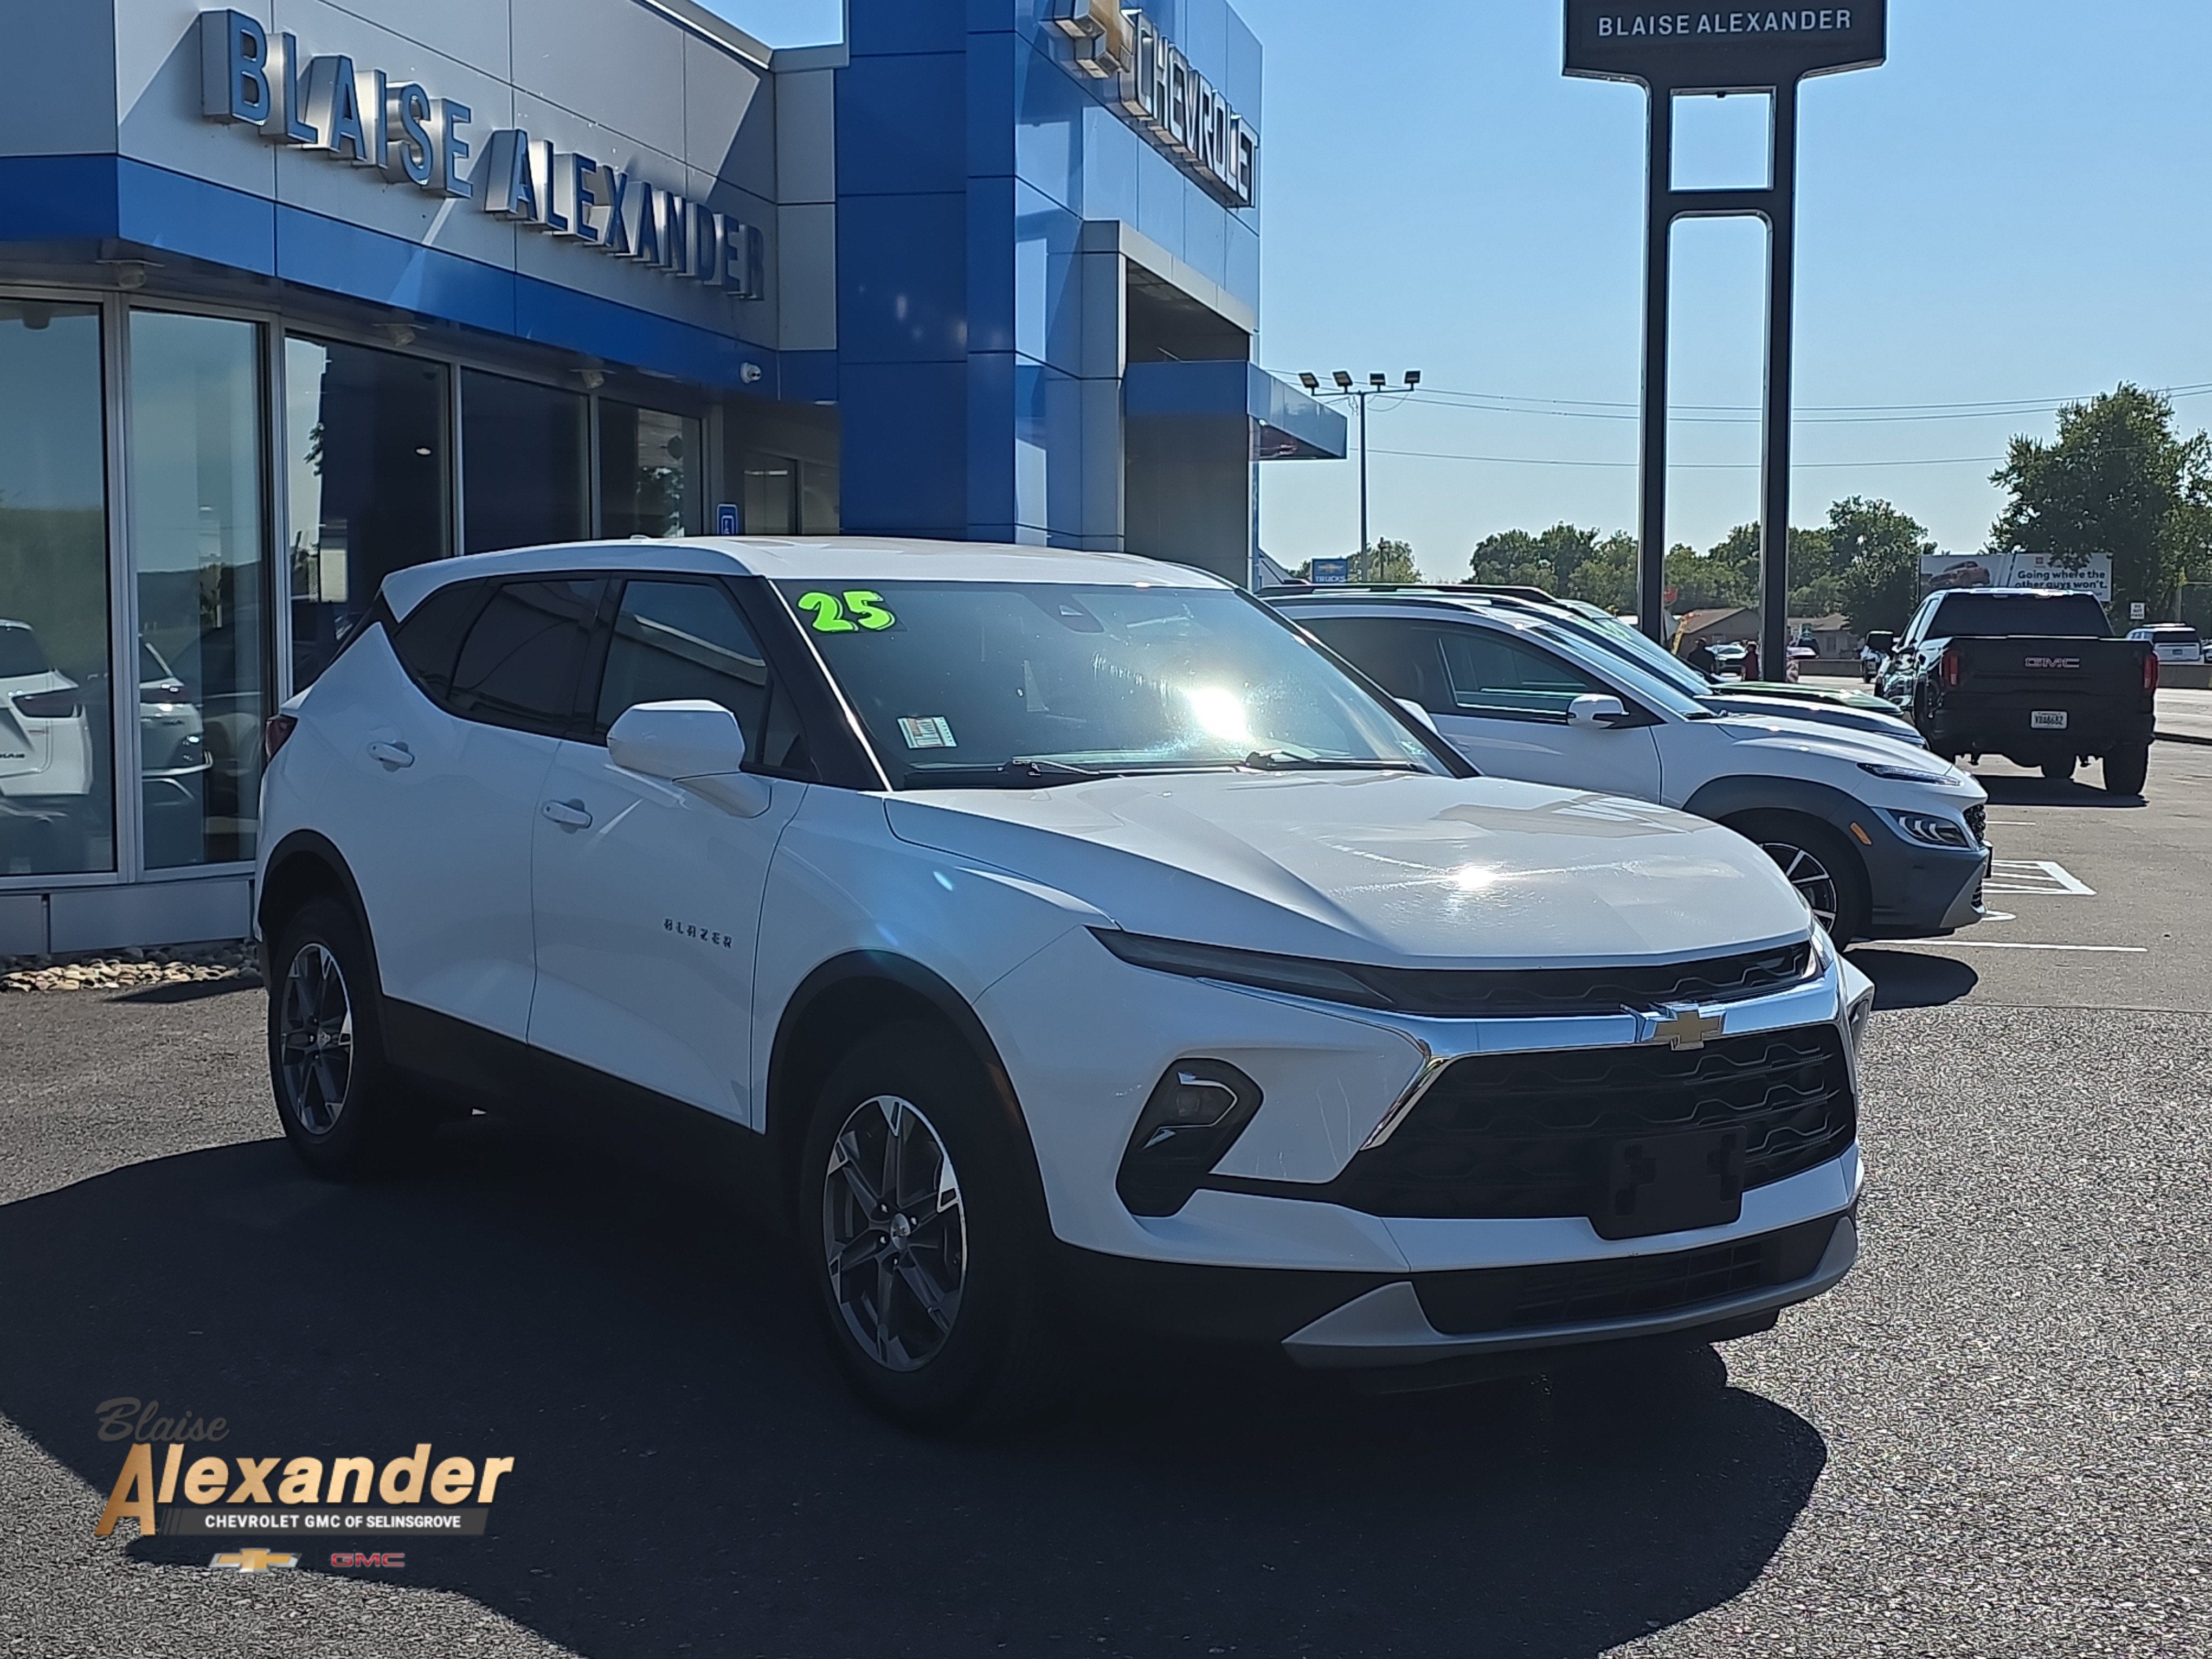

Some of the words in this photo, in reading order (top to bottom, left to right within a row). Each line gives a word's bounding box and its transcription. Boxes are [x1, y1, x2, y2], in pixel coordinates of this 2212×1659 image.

[1598, 14, 1690, 36] BLAISE
[1696, 9, 1852, 34] ALEXANDER
[1134, 10, 1259, 207] CHEVROLET
[203, 9, 473, 198] BLAISE
[485, 129, 766, 301] ALEXANDER
[2017, 570, 2049, 581] Going
[2053, 570, 2085, 578] where
[2087, 570, 2105, 578] the
[2073, 580, 2107, 589] won't.
[798, 590, 896, 632] 25
[2024, 657, 2080, 668] GMC
[663, 918, 732, 949] BLAZER
